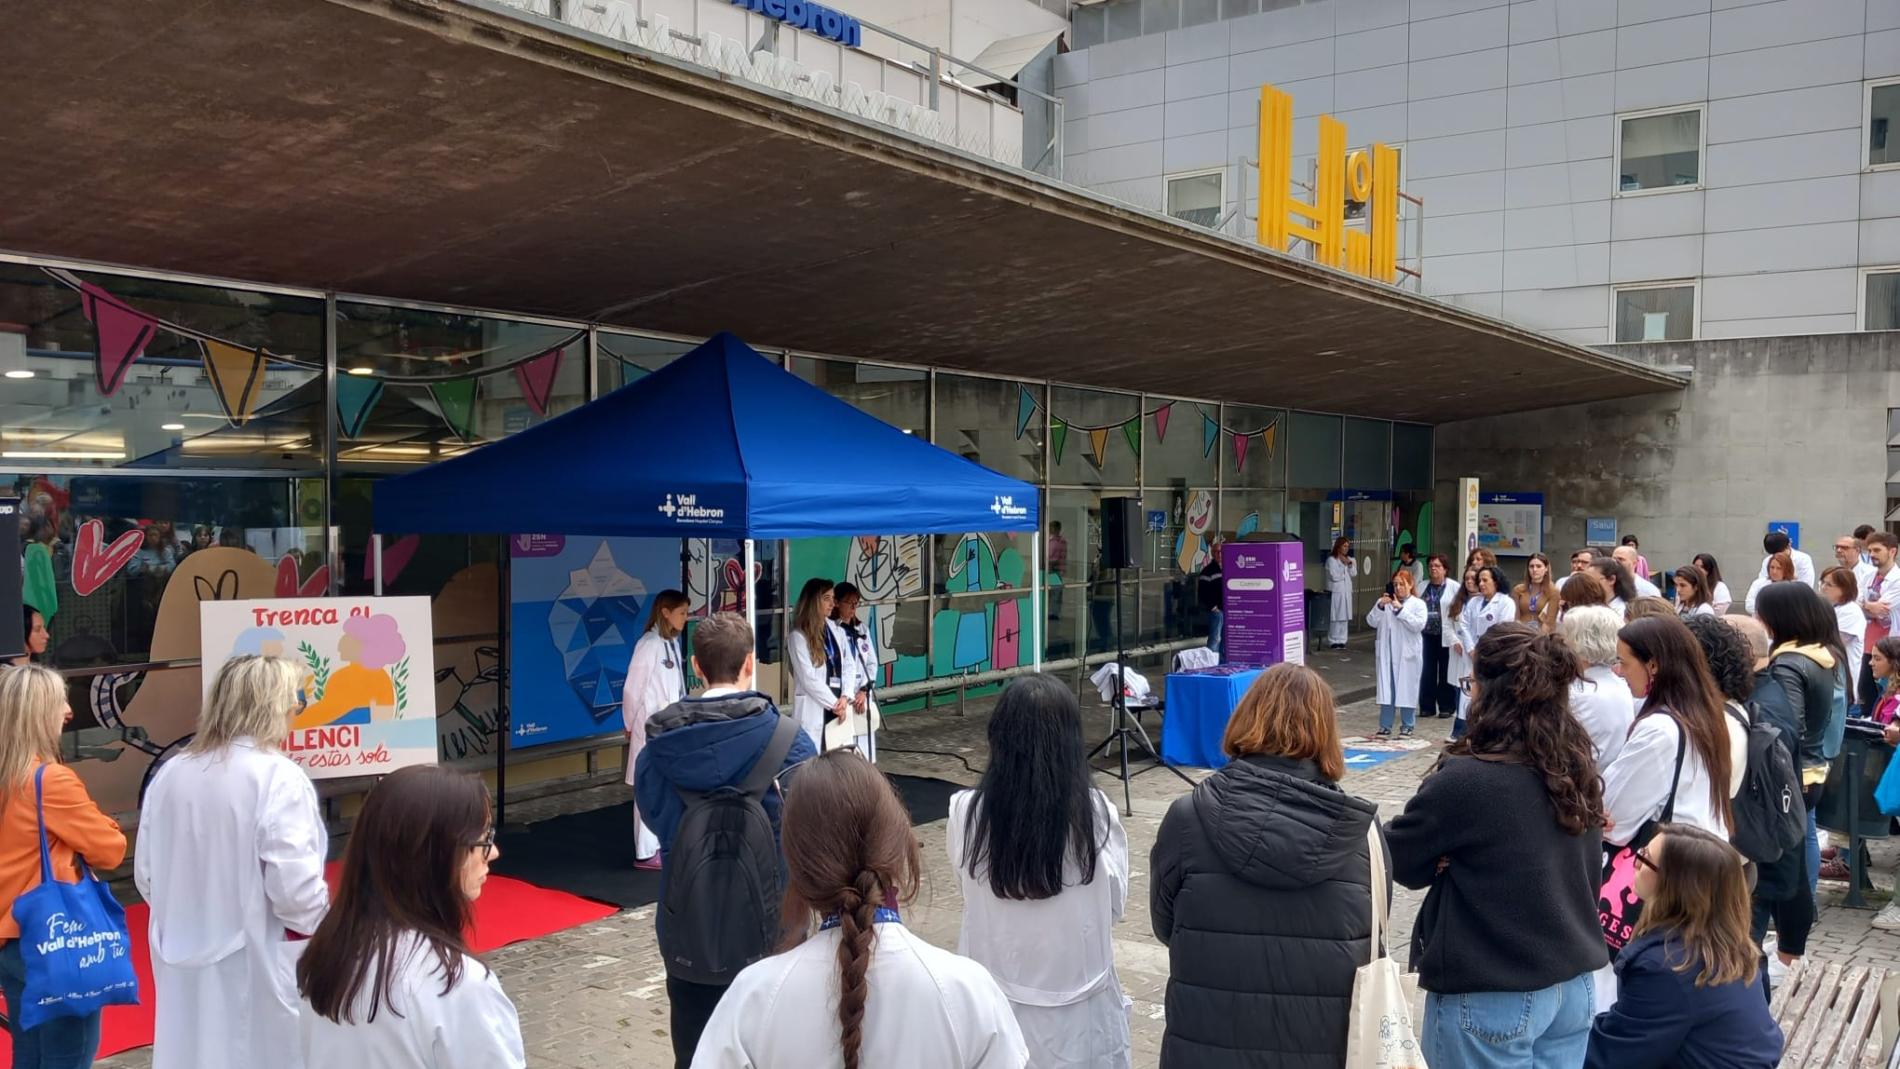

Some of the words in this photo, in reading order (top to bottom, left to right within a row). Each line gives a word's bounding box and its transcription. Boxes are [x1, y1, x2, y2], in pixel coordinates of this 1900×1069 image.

[676, 494, 696, 506] Vall
[677, 506, 724, 518] d'Hebron
[252, 606, 338, 627] Trenca
[279, 726, 360, 752] ILENCI
[356, 744, 391, 764] sola
[46, 912, 86, 940] Fem
[1599, 912, 1632, 940] GES
[37, 936, 65, 956] Vall
[66, 931, 120, 949] d'Hebron
[79, 941, 105, 969] amb
